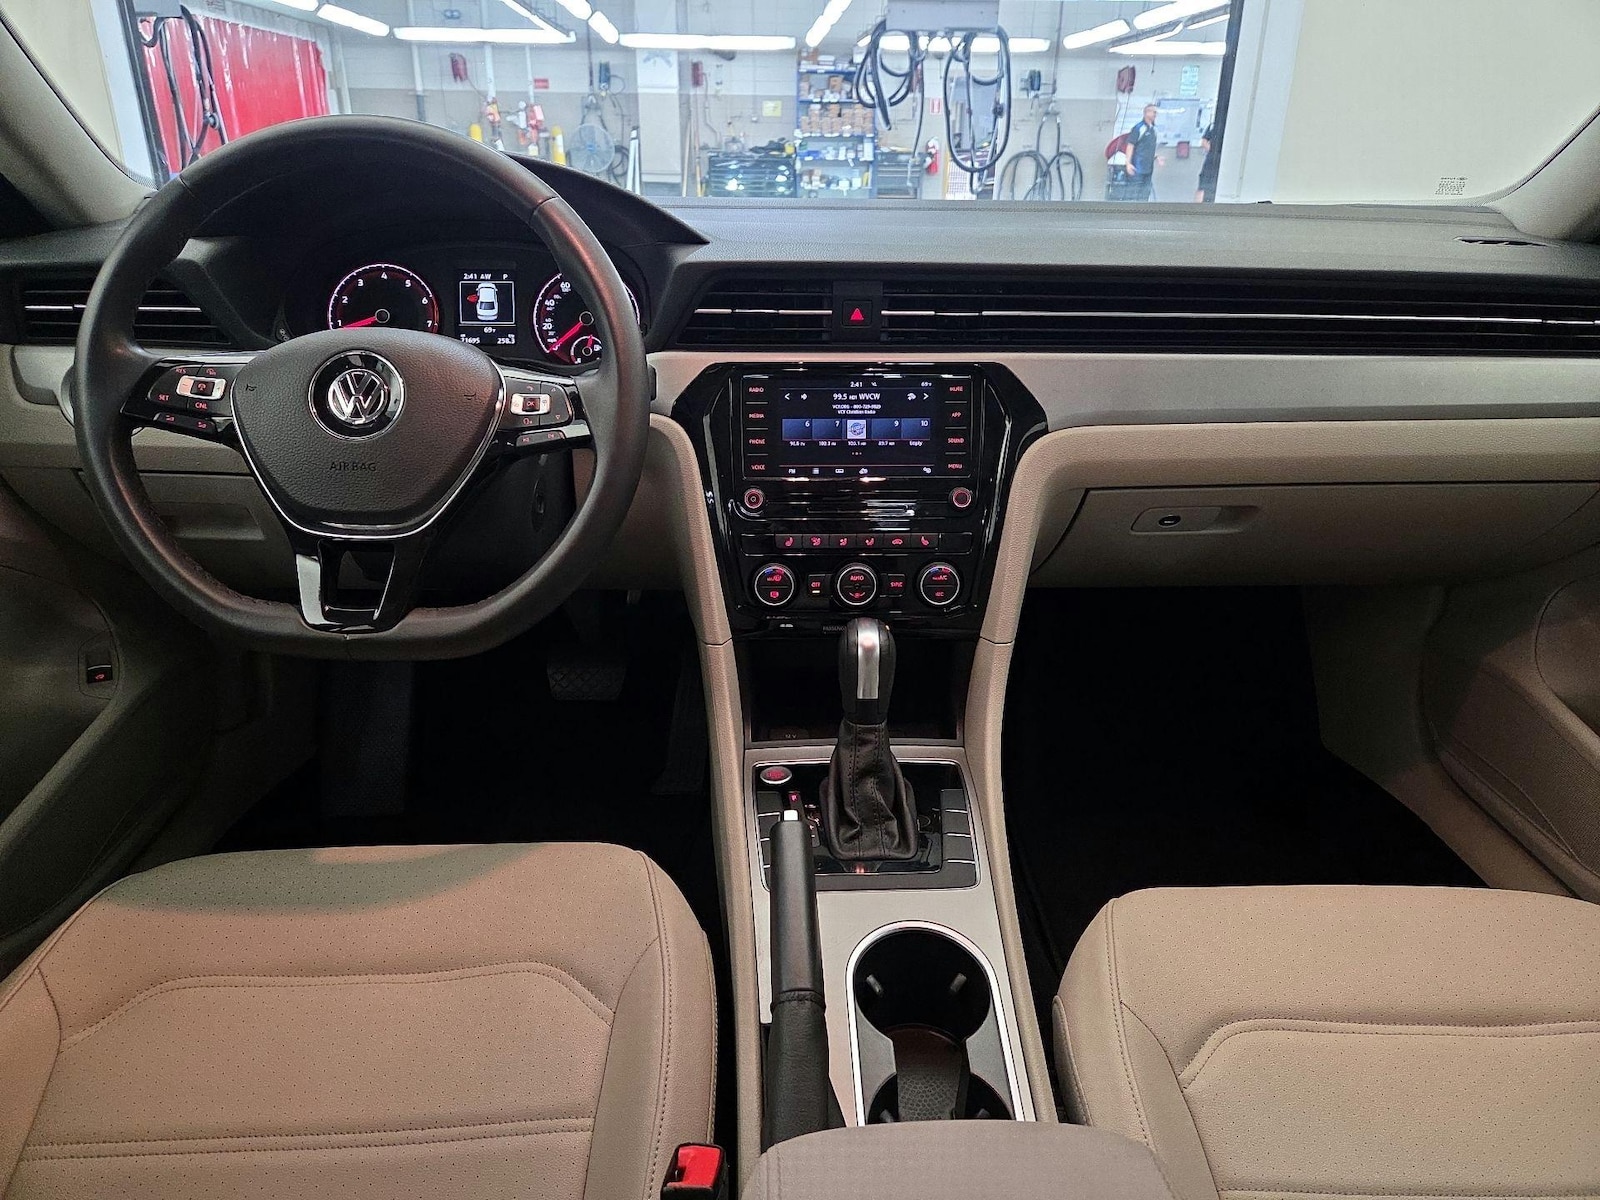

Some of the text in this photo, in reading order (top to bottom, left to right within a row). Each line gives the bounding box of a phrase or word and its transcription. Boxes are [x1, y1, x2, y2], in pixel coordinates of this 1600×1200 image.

[381, 272, 388, 280] 4
[357, 279, 364, 287] 3
[405, 279, 412, 288] 5
[560, 281, 571, 289] 60
[341, 295, 348, 304] 2
[421, 296, 428, 305] 6
[544, 299, 555, 307] 40
[337, 319, 342, 327] 1
[426, 320, 432, 328] 7
[194, 401, 208, 410] CNL
[329, 461, 377, 472] AIRBAG
